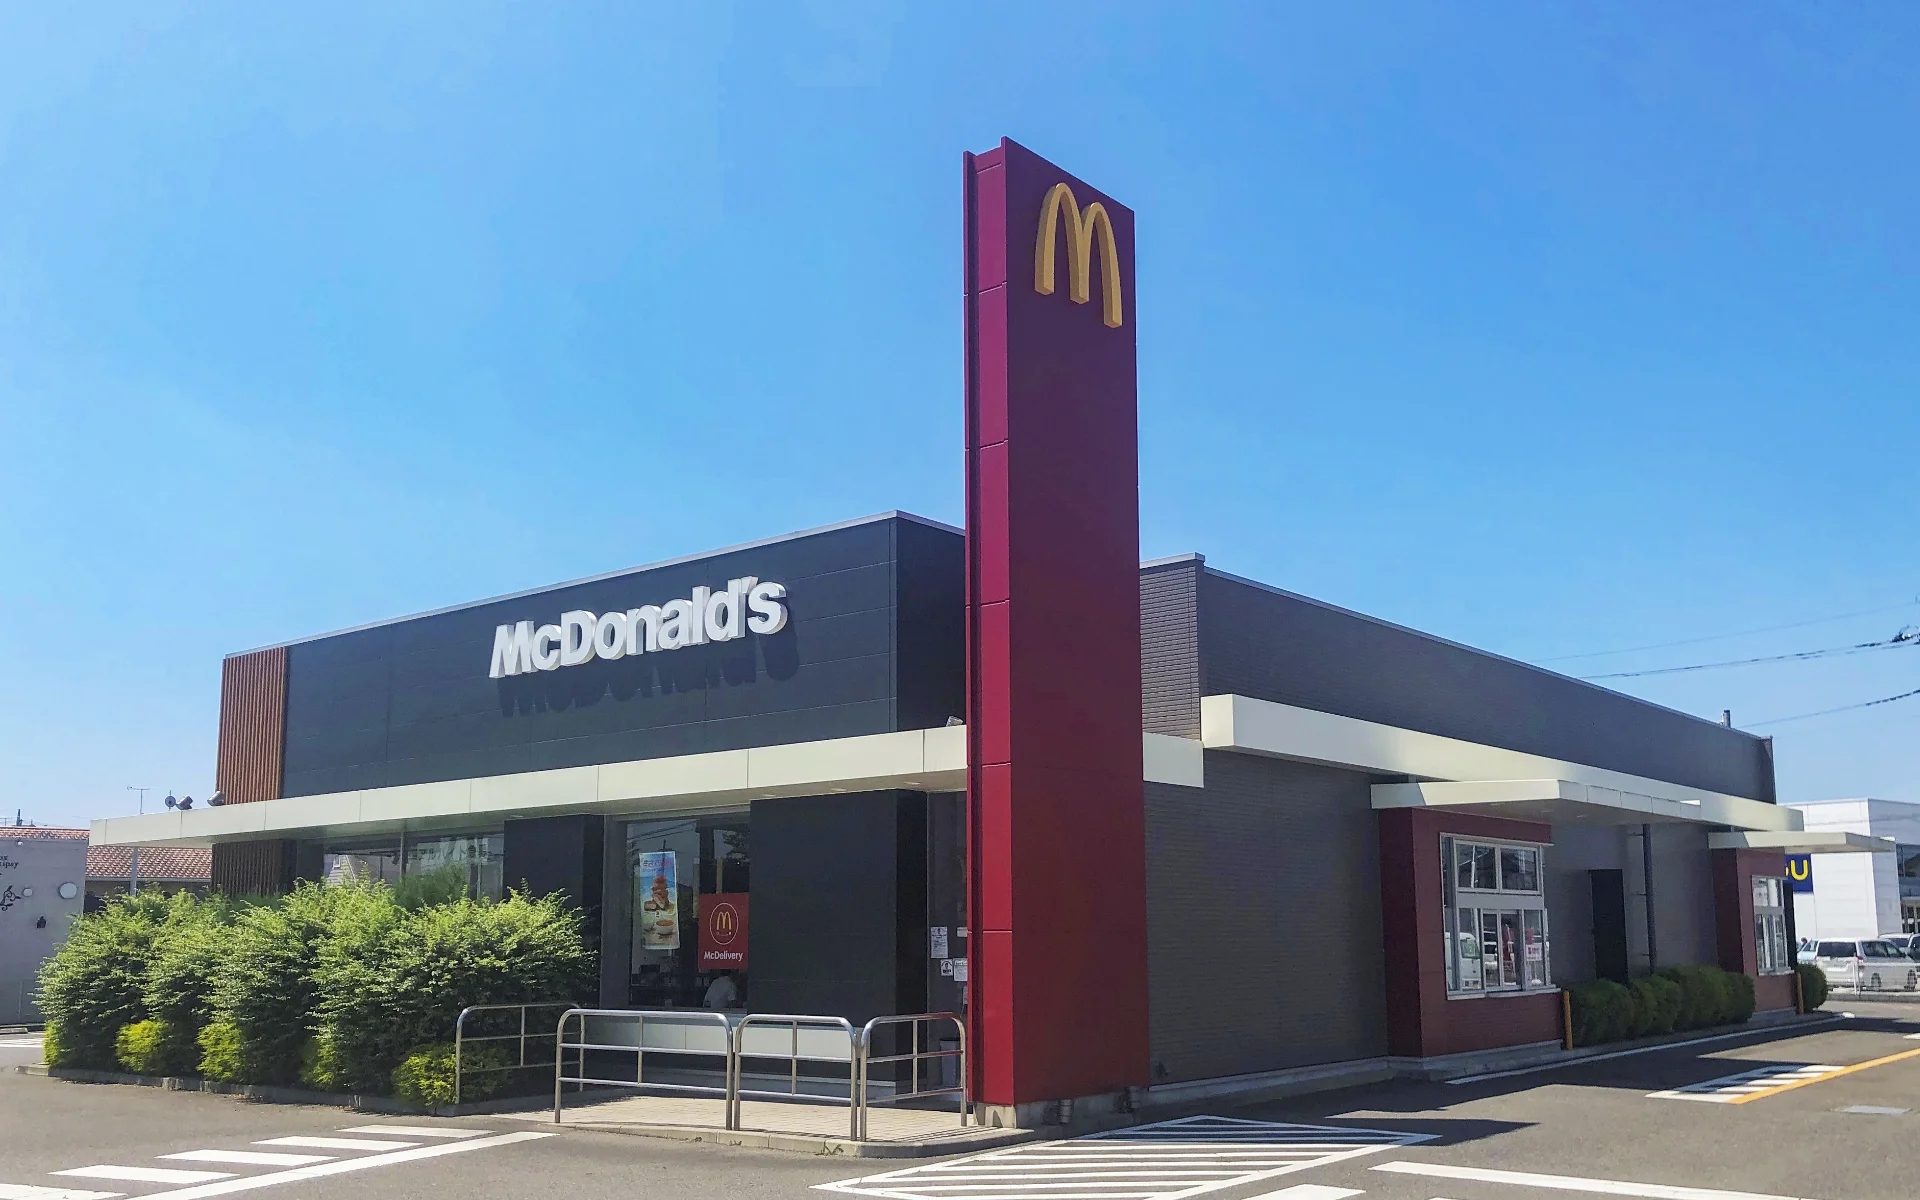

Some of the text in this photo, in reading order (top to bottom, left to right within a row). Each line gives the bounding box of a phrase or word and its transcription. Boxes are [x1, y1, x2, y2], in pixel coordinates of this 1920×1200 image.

[488, 575, 788, 679] McDonald's
[1785, 859, 1809, 881] U
[703, 949, 744, 962] McDelivery
